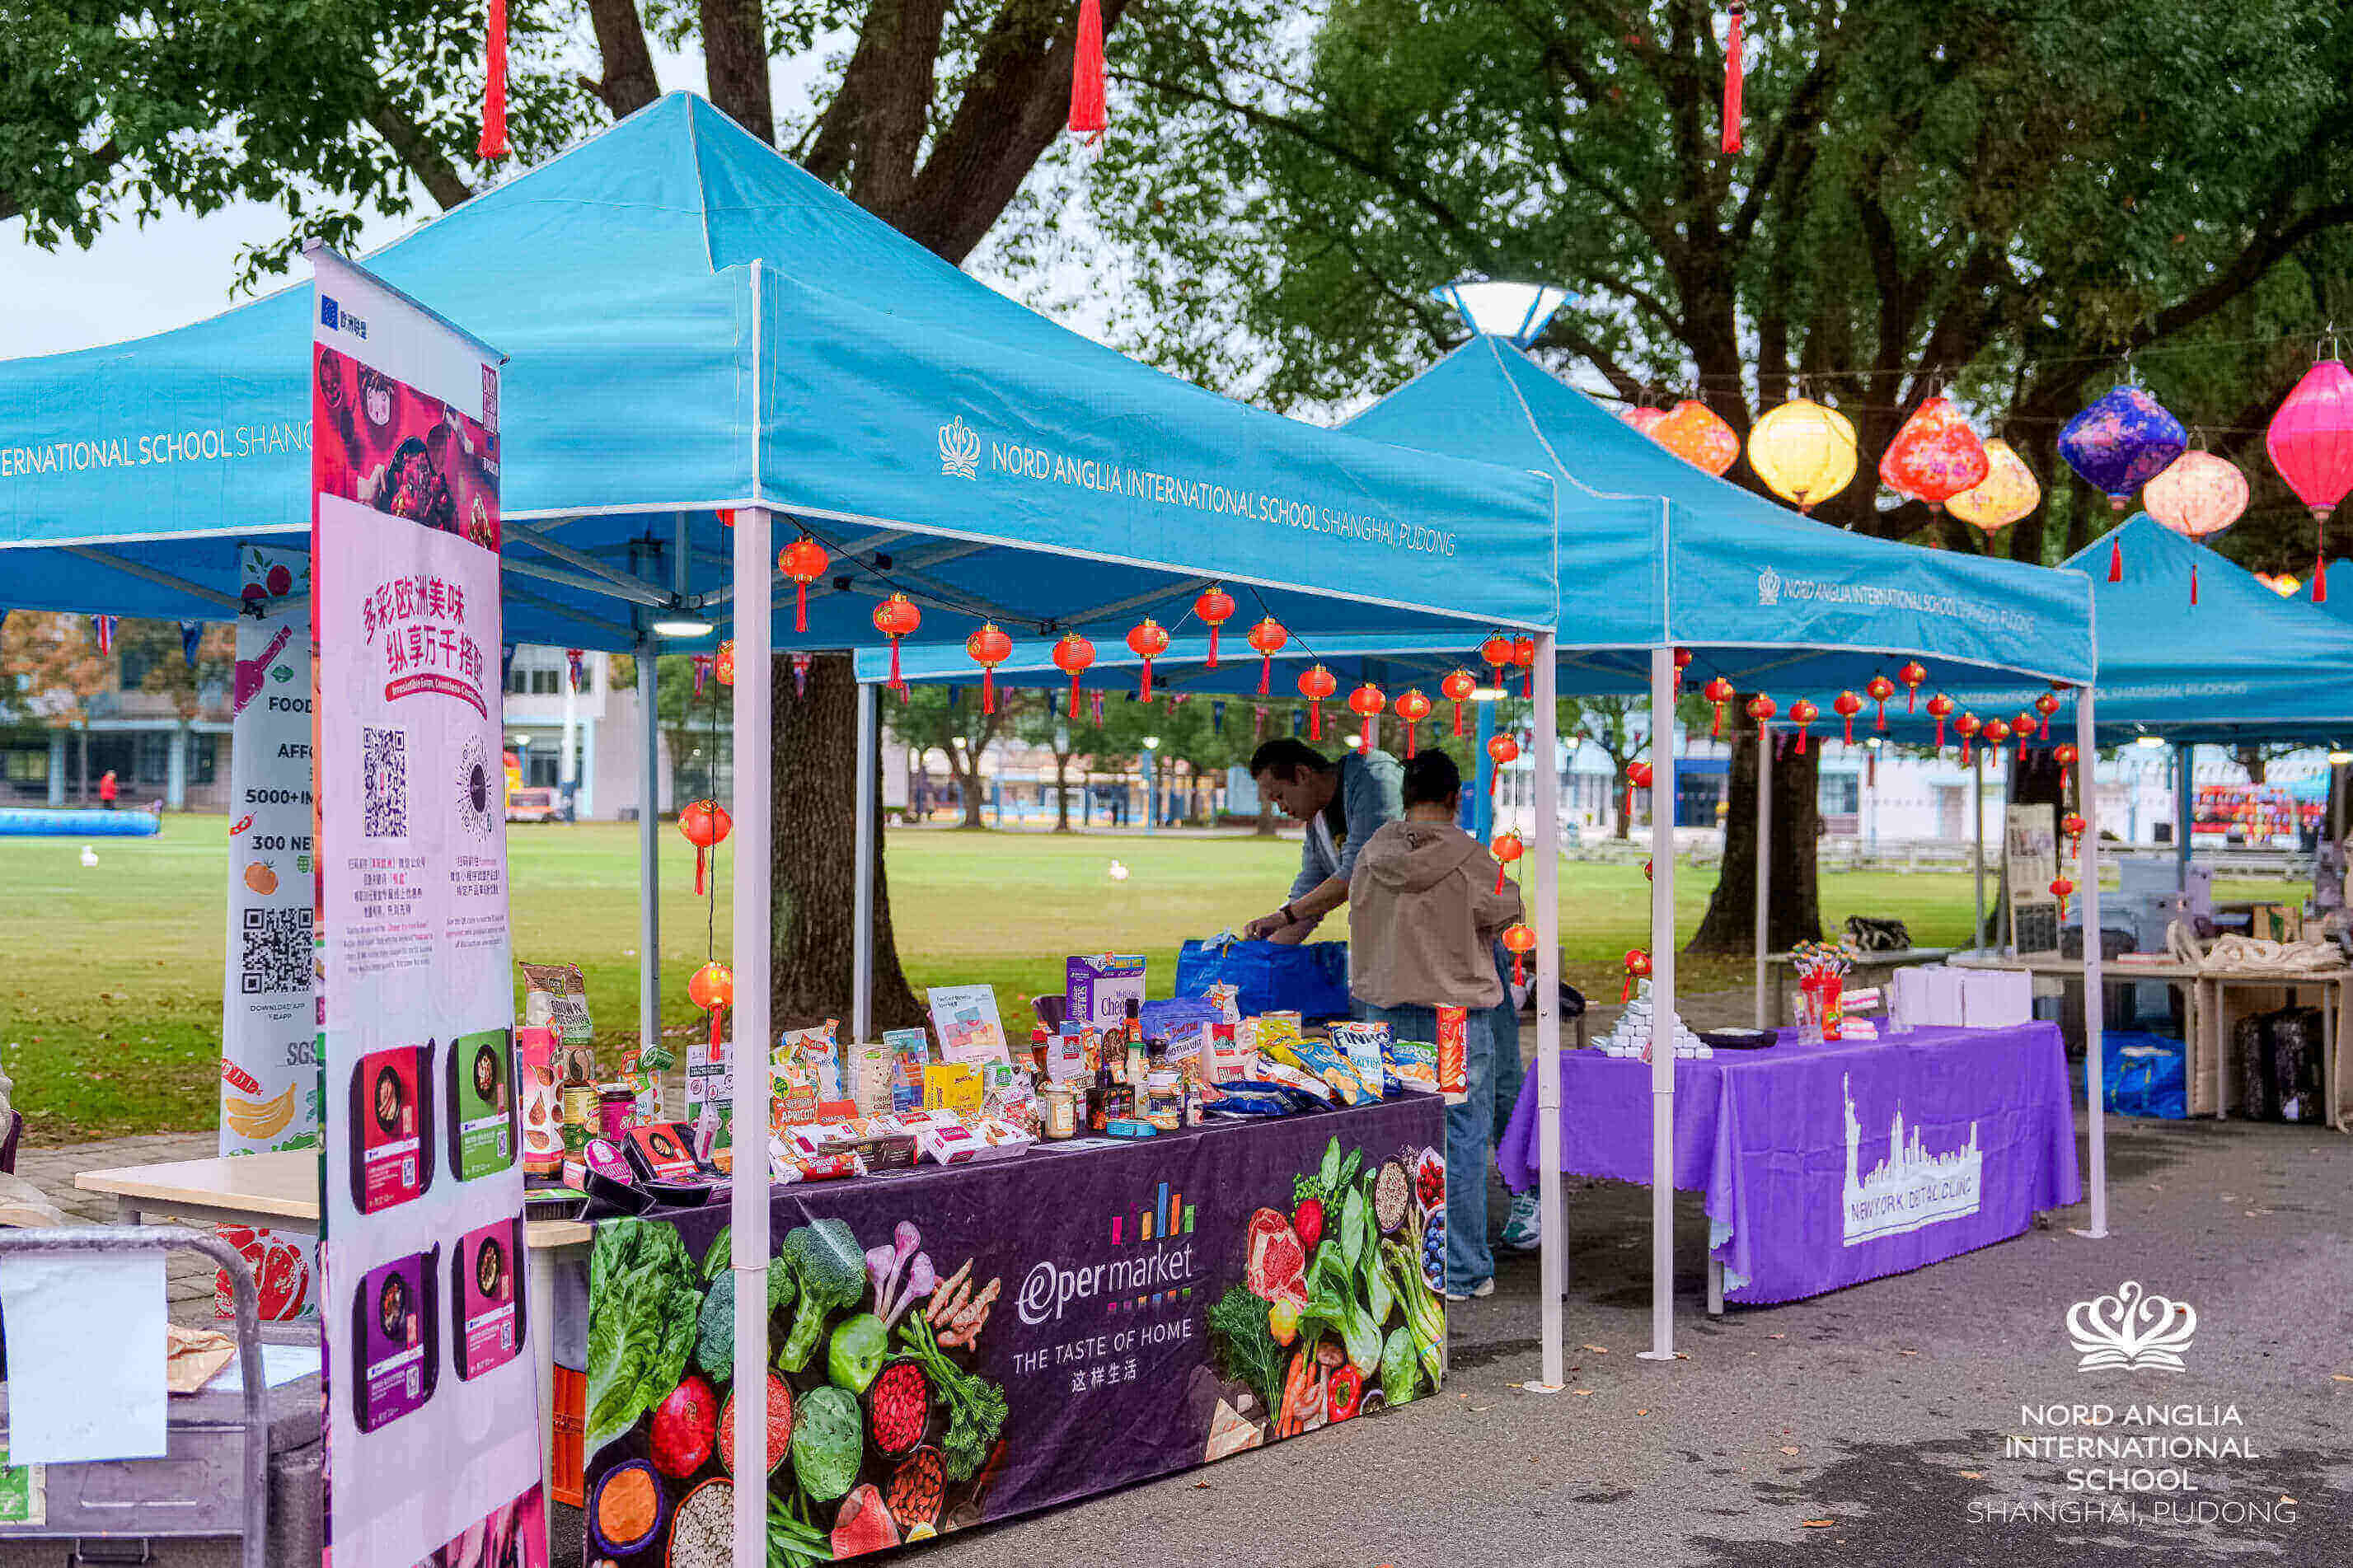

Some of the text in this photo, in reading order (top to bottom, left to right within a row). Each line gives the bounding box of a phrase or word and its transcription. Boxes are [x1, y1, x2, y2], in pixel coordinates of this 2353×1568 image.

[0, 438, 134, 477] ERNATIONAL
[139, 428, 232, 465] SCHOOL
[991, 441, 1456, 557] NORD ANGLIA INTERNATIONAL SCHOOL SHANGHAI, PUDONG
[363, 575, 465, 646] 多彩欧洲美味
[1783, 579, 1813, 599] NORD
[1813, 582, 1852, 602] ANGLIA
[1852, 585, 1924, 611] INTERNATIONAL
[277, 743, 313, 759] AFF
[252, 835, 314, 850] 300 NE
[1011, 1318, 1194, 1374] THE TASTE OF HOME
[1071, 1358, 1137, 1393] 这样生活
